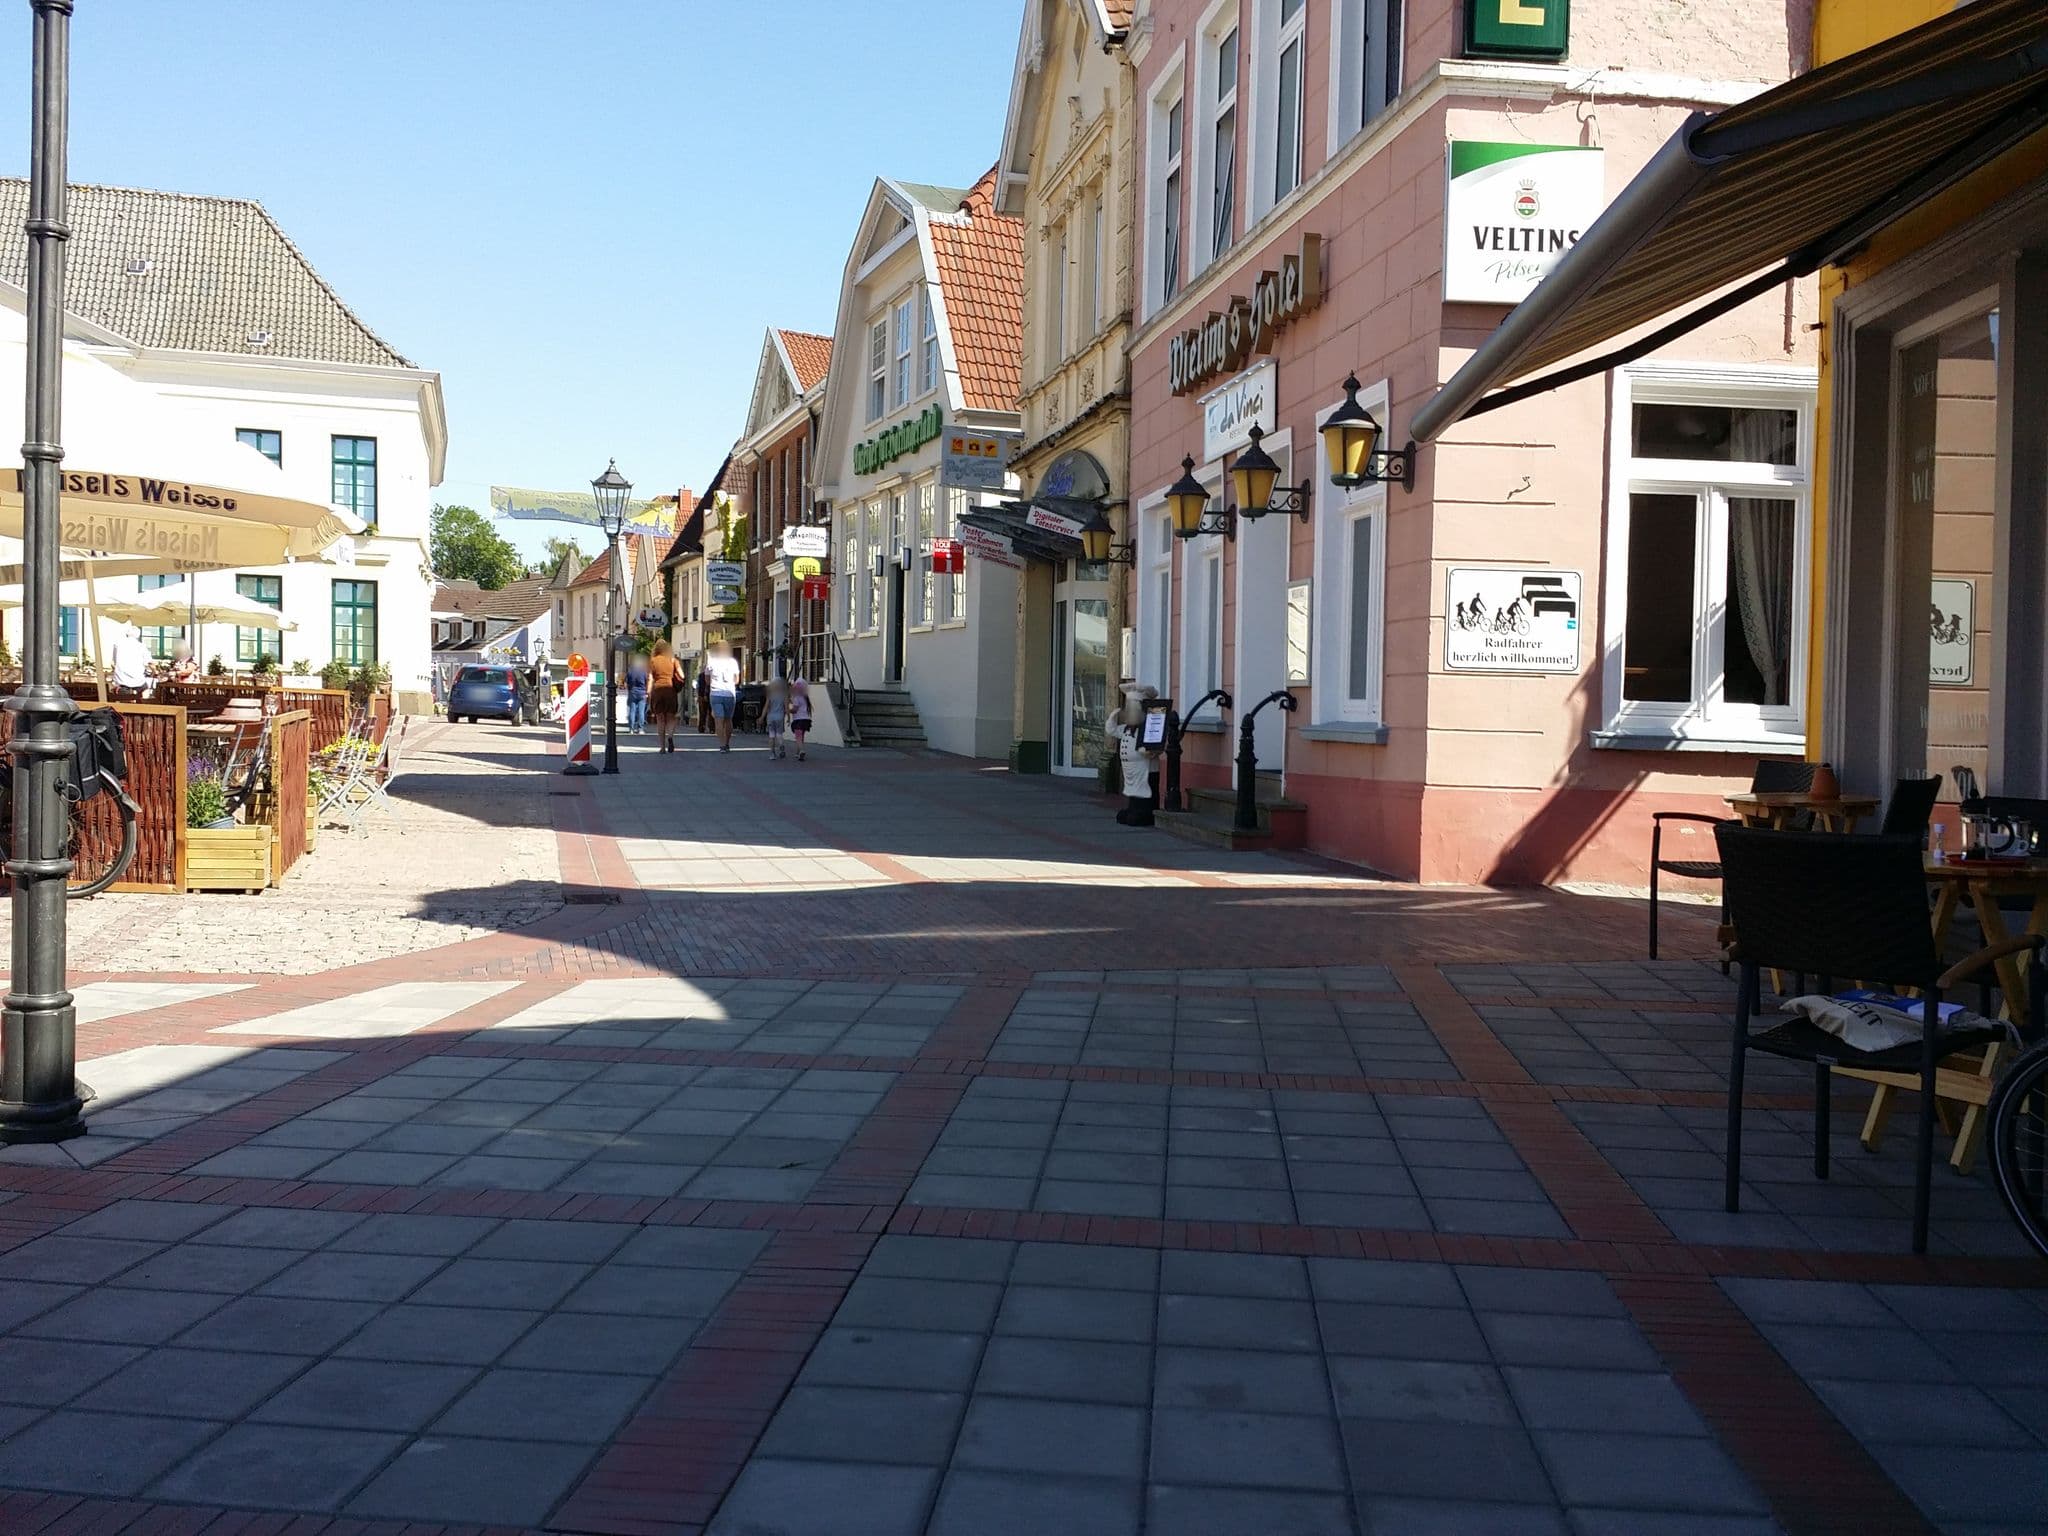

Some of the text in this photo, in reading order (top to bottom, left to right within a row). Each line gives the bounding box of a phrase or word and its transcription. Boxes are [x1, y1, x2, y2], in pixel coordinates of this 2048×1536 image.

[1249, 234, 1310, 353] Hotel
[1219, 382, 1265, 433] da Vinci
[139, 478, 238, 511] Weisse
[1033, 510, 1064, 525] Digitaler
[963, 525, 986, 537] Poster
[1035, 518, 1075, 535] Fotoservice
[1485, 637, 1543, 649] Radfahrer
[1453, 651, 1573, 665] herzlich willkommen!
